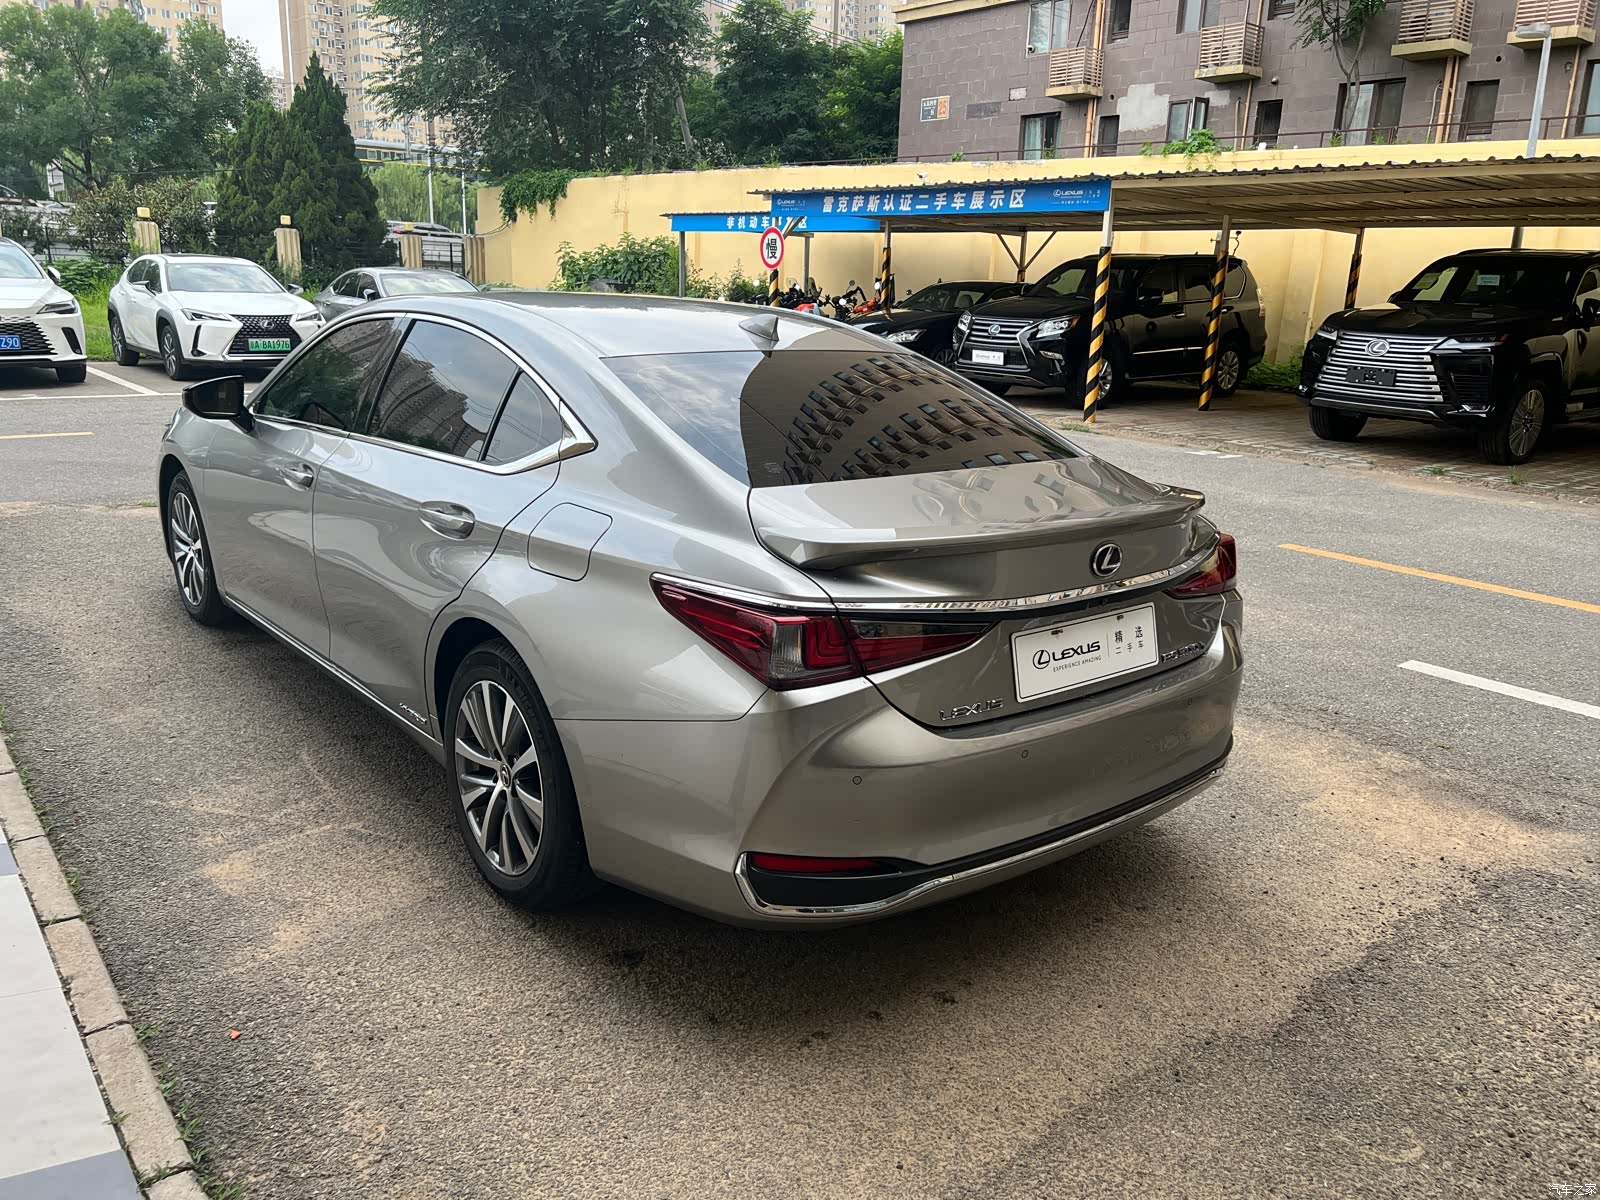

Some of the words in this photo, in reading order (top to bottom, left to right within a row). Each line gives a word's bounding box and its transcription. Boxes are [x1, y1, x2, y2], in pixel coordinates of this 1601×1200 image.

[822, 189, 1026, 213] 雷克萨斯认证二手车展示区
[726, 215, 808, 229] 非机动车区
[765, 238, 778, 259] 慢
[1115, 625, 1143, 643] 精选
[1052, 641, 1101, 661] LEXUS
[1053, 661, 1081, 673] EXPERIENCE
[1081, 655, 1102, 665] AMAZING
[939, 697, 1004, 721] LEXUS
